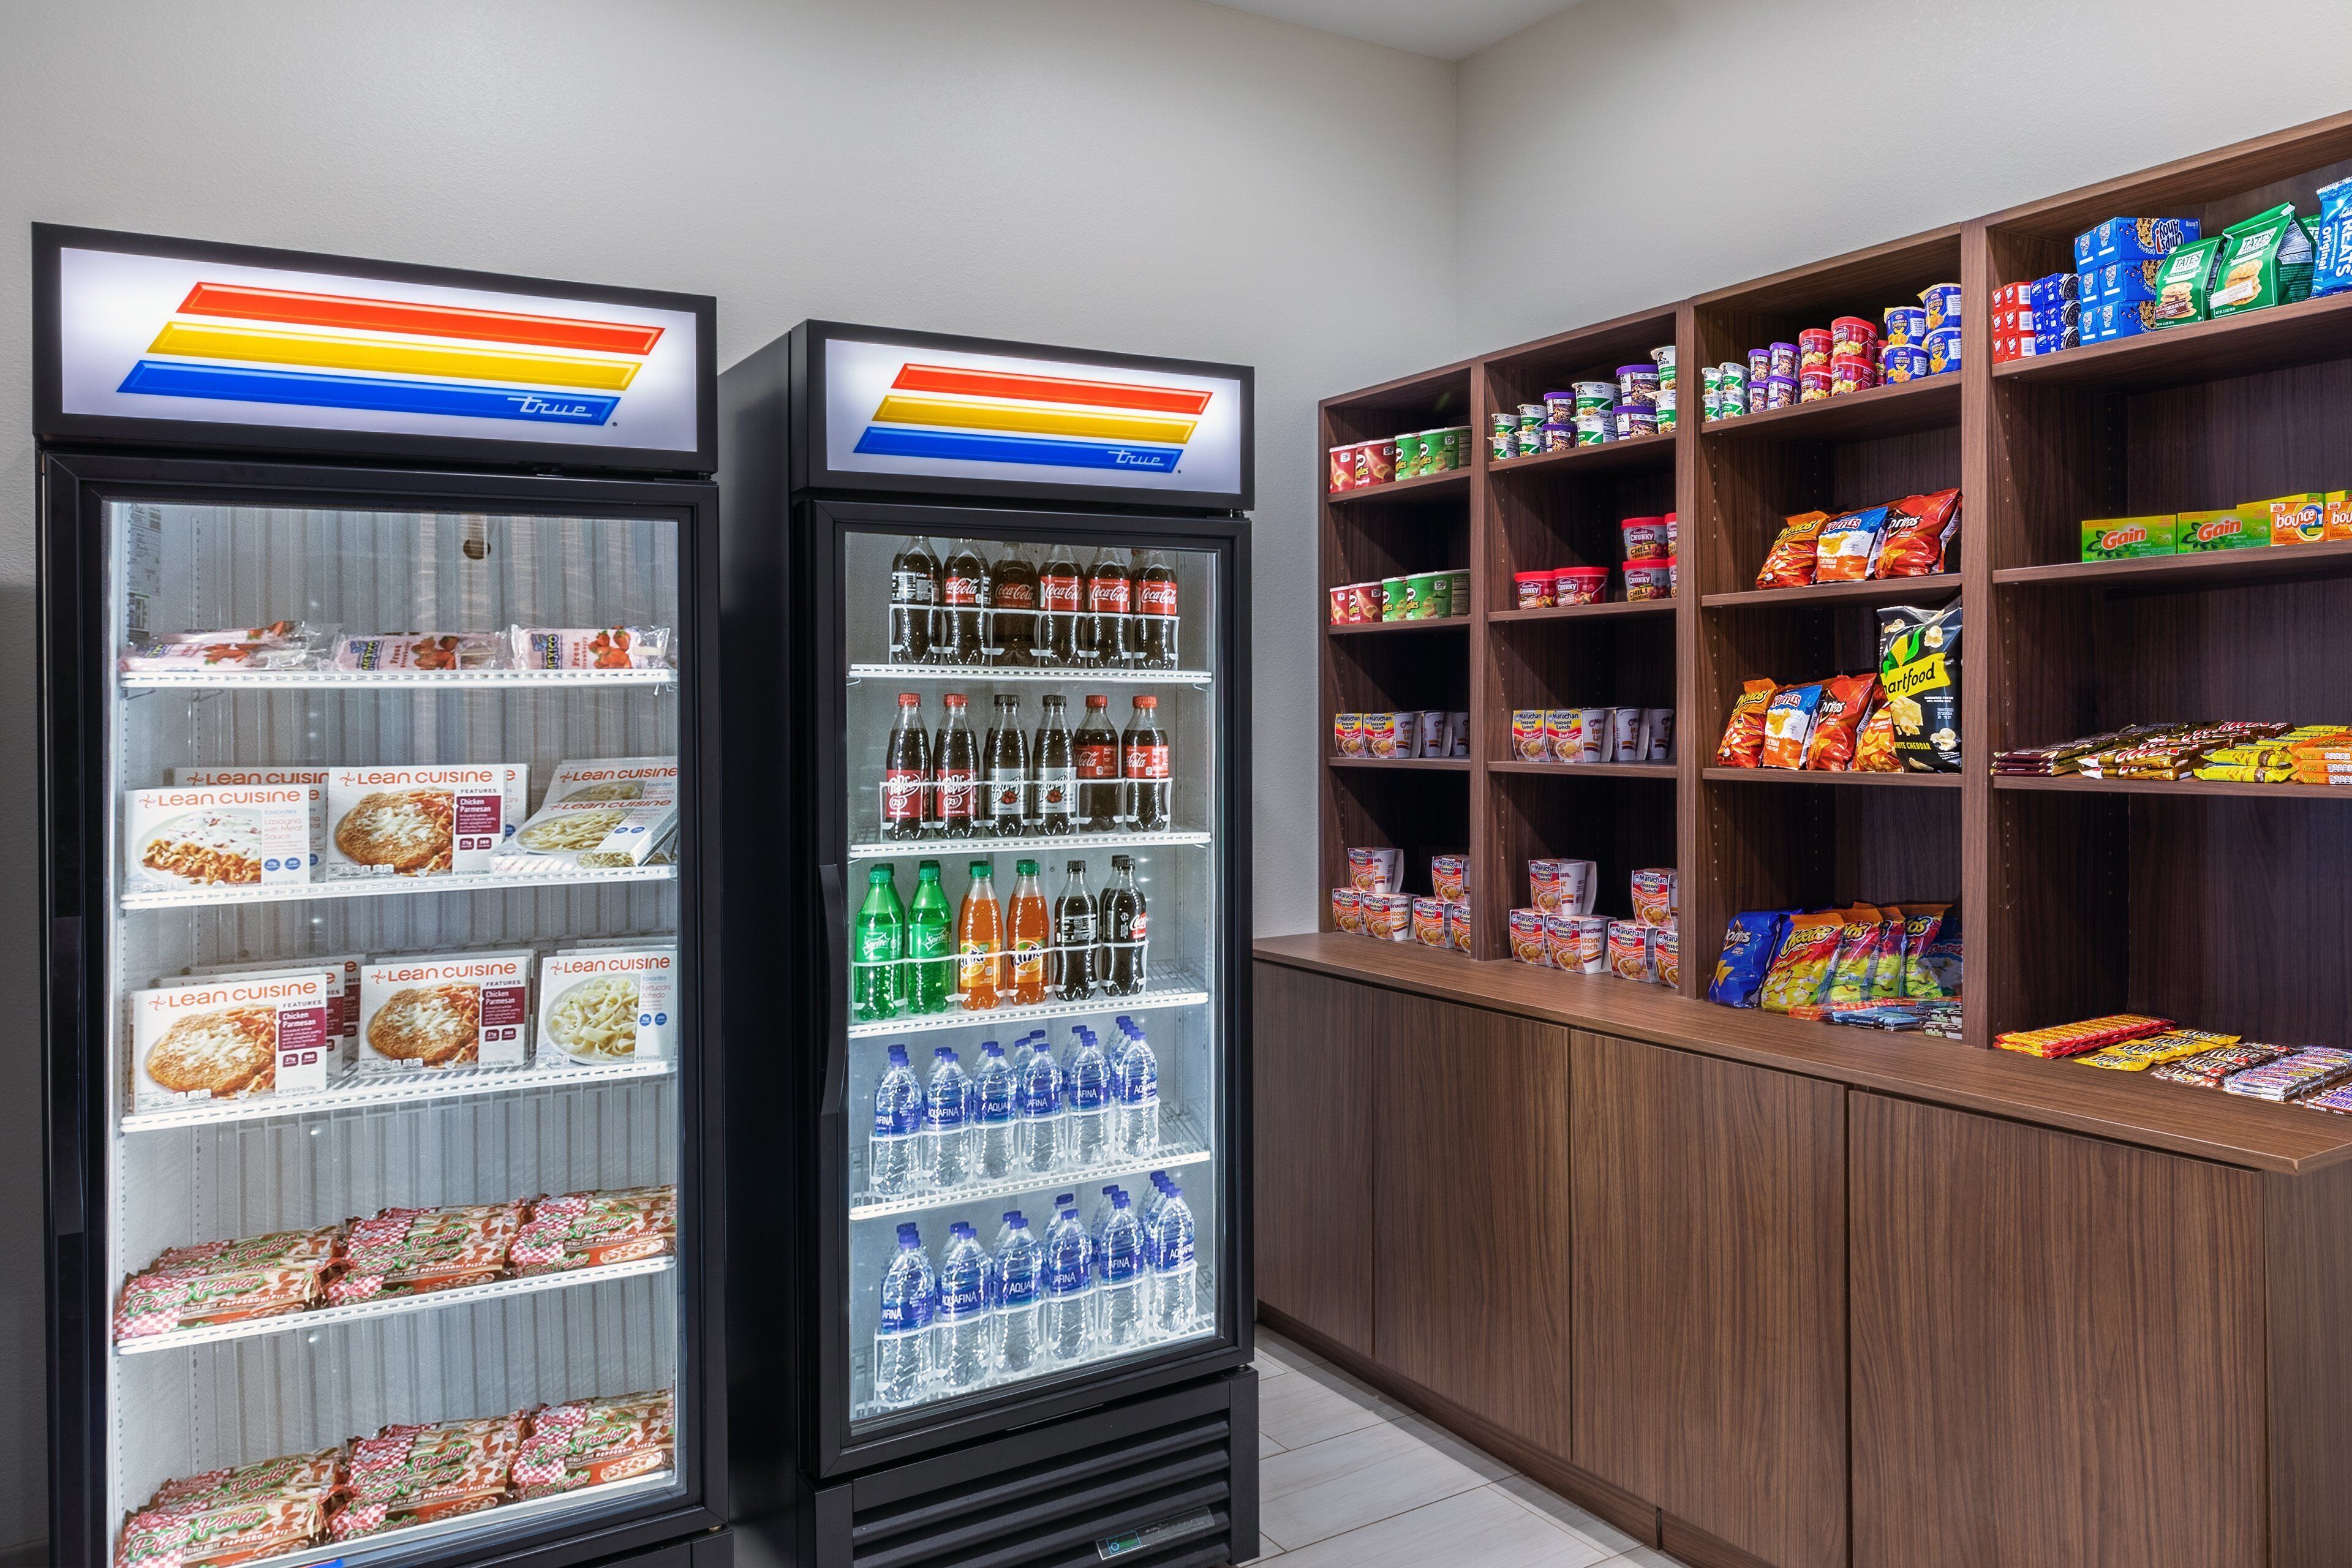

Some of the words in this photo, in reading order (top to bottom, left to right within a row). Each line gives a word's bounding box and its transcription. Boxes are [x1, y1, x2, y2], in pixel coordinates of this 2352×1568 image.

[2244, 230, 2274, 247] TATE'S
[2137, 241, 2155, 255] ORIGINAL
[2318, 225, 2329, 271] Original
[2176, 250, 2201, 268] TATE'S
[507, 395, 592, 418] true
[1107, 450, 1164, 466] true
[1824, 519, 1860, 533] RUFFLES
[2275, 508, 2316, 530] bounce
[1630, 533, 1654, 541] CHUNKY
[2197, 519, 2242, 542] Gain
[2101, 528, 2146, 551] Gain
[1630, 546, 1651, 554] CHILI
[995, 583, 1034, 601] Coca-Cola
[1046, 582, 1082, 601] Coca-Cola
[1091, 584, 1129, 603] Coca-Cola
[1141, 586, 1177, 605] Coca-Cola
[1629, 589, 1648, 597] CHILI
[1774, 695, 1801, 708] RUFFLES
[1906, 742, 1931, 750] CHEDDAR
[206, 773, 262, 785] Lean
[265, 772, 329, 784] cuisin
[357, 771, 410, 785] Lean
[415, 770, 492, 783] cuisine
[573, 770, 613, 781] Lean
[617, 767, 677, 778] cuisine
[899, 774, 910, 784] Dr
[951, 774, 964, 784] Dr
[158, 793, 214, 806] Lean
[219, 790, 301, 804] cuisine
[608, 800, 672, 809] cuisine
[1439, 860, 1461, 869] Maruchan
[1534, 864, 1558, 873] Maruchan
[1640, 874, 1668, 884] Maruchan
[1338, 892, 1359, 900] Maruchan
[1419, 903, 1442, 911] Maruchan
[1517, 914, 1542, 924] Maruchan
[1553, 921, 1580, 930] Maruchan
[927, 933, 950, 946] Sprite
[1615, 928, 1644, 938] Maruchan
[864, 938, 889, 950] Sprite
[1781, 925, 1834, 957] Cheetos
[388, 968, 437, 981] Lean
[442, 963, 516, 978] cuisine
[564, 960, 605, 973] Lean
[609, 957, 671, 970] cuisine
[168, 990, 227, 1008] Lean
[233, 982, 317, 1001] cuisine
[283, 1019, 316, 1028] Parmesan
[576, 1216, 629, 1236] Parlor
[410, 1226, 467, 1248] Parlor
[595, 1234, 636, 1243] PEPPERONI
[420, 1264, 464, 1273] PEPPERONI
[556, 1256, 589, 1269] Parlor
[131, 1289, 190, 1313] Pizza
[196, 1276, 262, 1297] Parlor
[220, 1296, 270, 1308] PEPPERONI
[576, 1427, 628, 1448] Parlor
[413, 1444, 469, 1471] Parlor
[596, 1447, 635, 1457] PEPPERONI
[557, 1471, 589, 1490] Parlor
[423, 1488, 467, 1498] PEPPERONI
[132, 1528, 192, 1556] Pizza
[197, 1509, 264, 1536] Parlor
[223, 1532, 273, 1547] PEPPERONI
